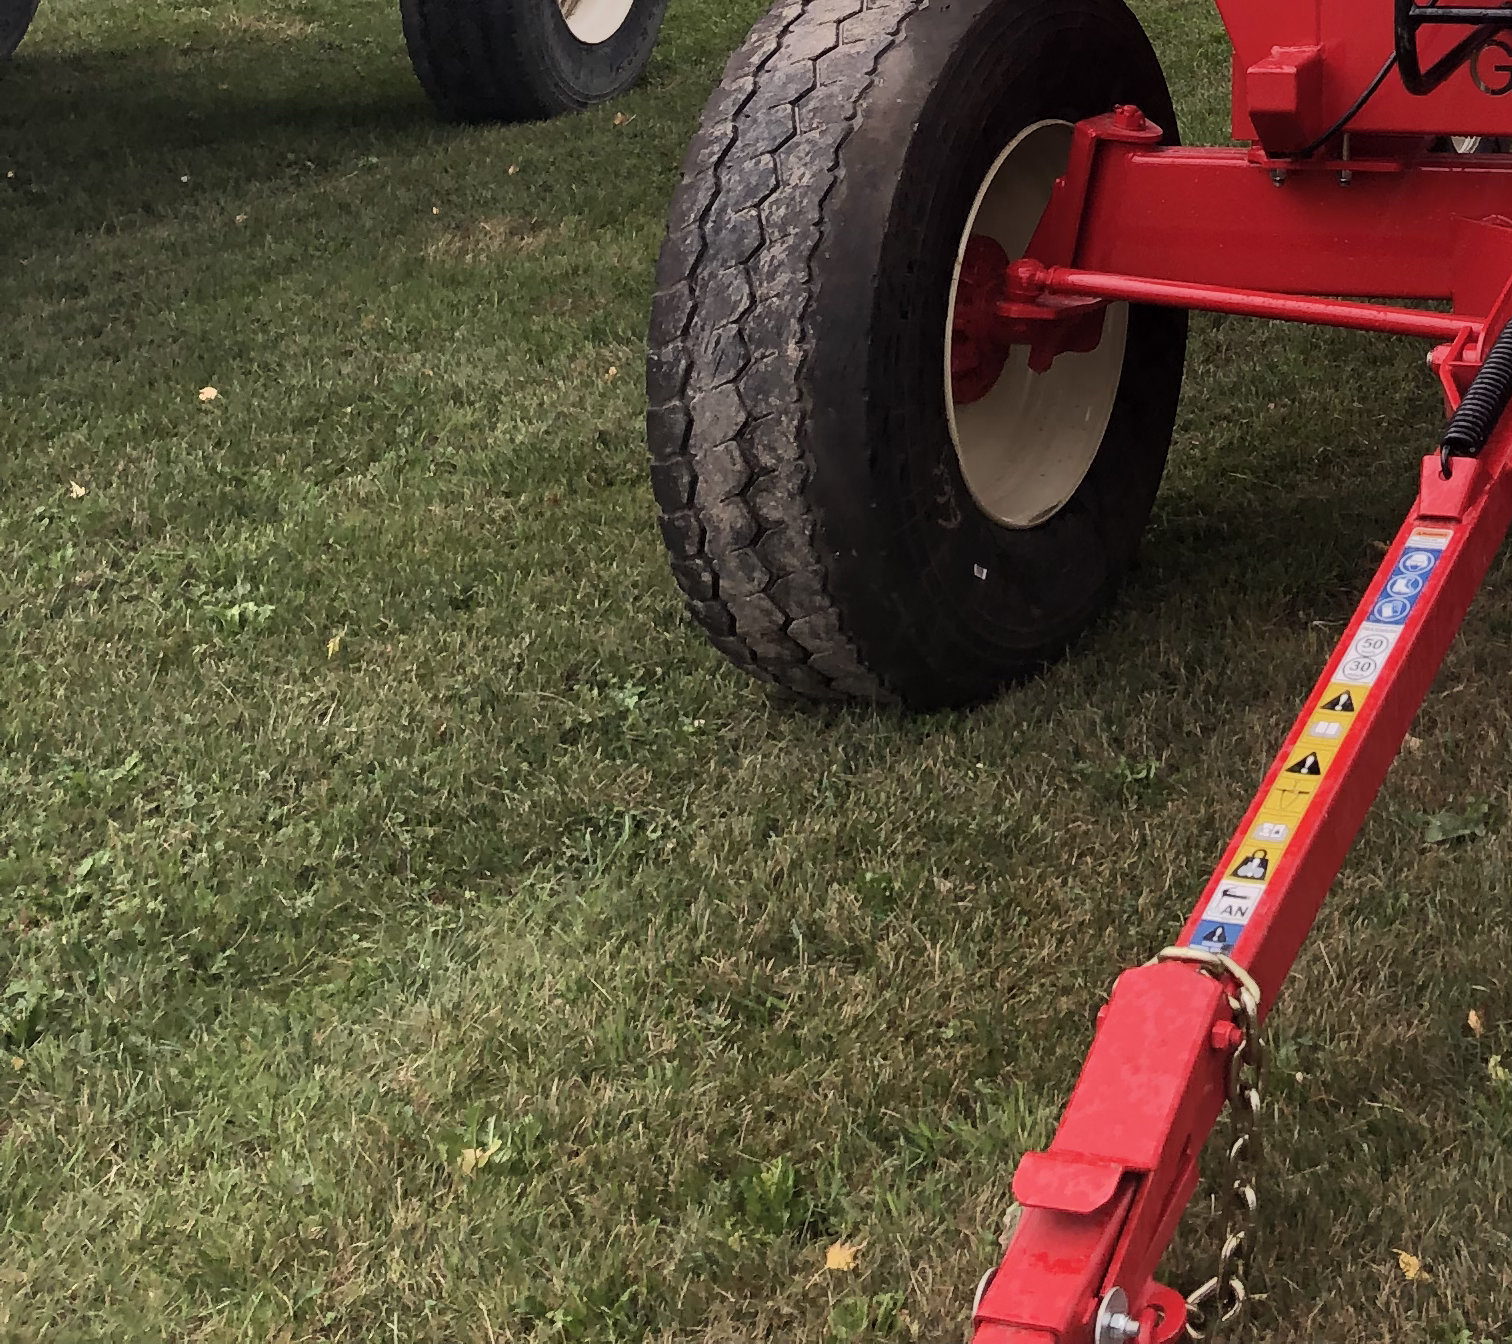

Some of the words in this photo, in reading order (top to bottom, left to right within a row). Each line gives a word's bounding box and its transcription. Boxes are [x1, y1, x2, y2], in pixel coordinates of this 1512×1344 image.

[1361, 638, 1384, 650] 50
[1349, 660, 1371, 672] 30
[1221, 905, 1249, 917] AN
